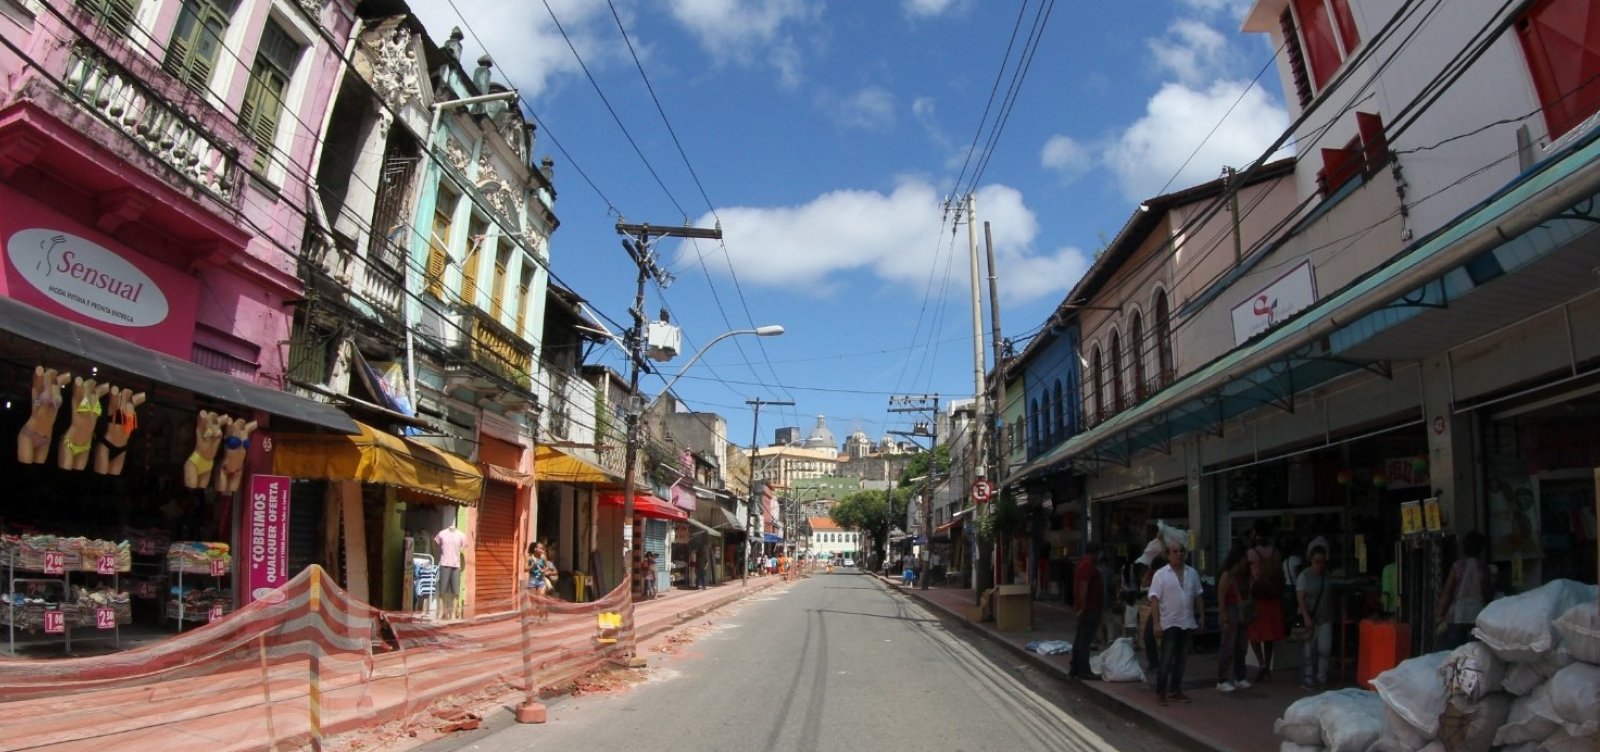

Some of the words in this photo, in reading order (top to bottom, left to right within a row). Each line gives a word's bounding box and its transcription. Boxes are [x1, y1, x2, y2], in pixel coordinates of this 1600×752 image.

[57, 251, 143, 303] Sensual
[48, 285, 66, 297] MODA
[91, 301, 111, 314] PRONTA
[111, 309, 134, 323] ENTREGA
[269, 482, 279, 523] OFERTA
[976, 484, 986, 497] E
[267, 525, 277, 583] QUALQUER
